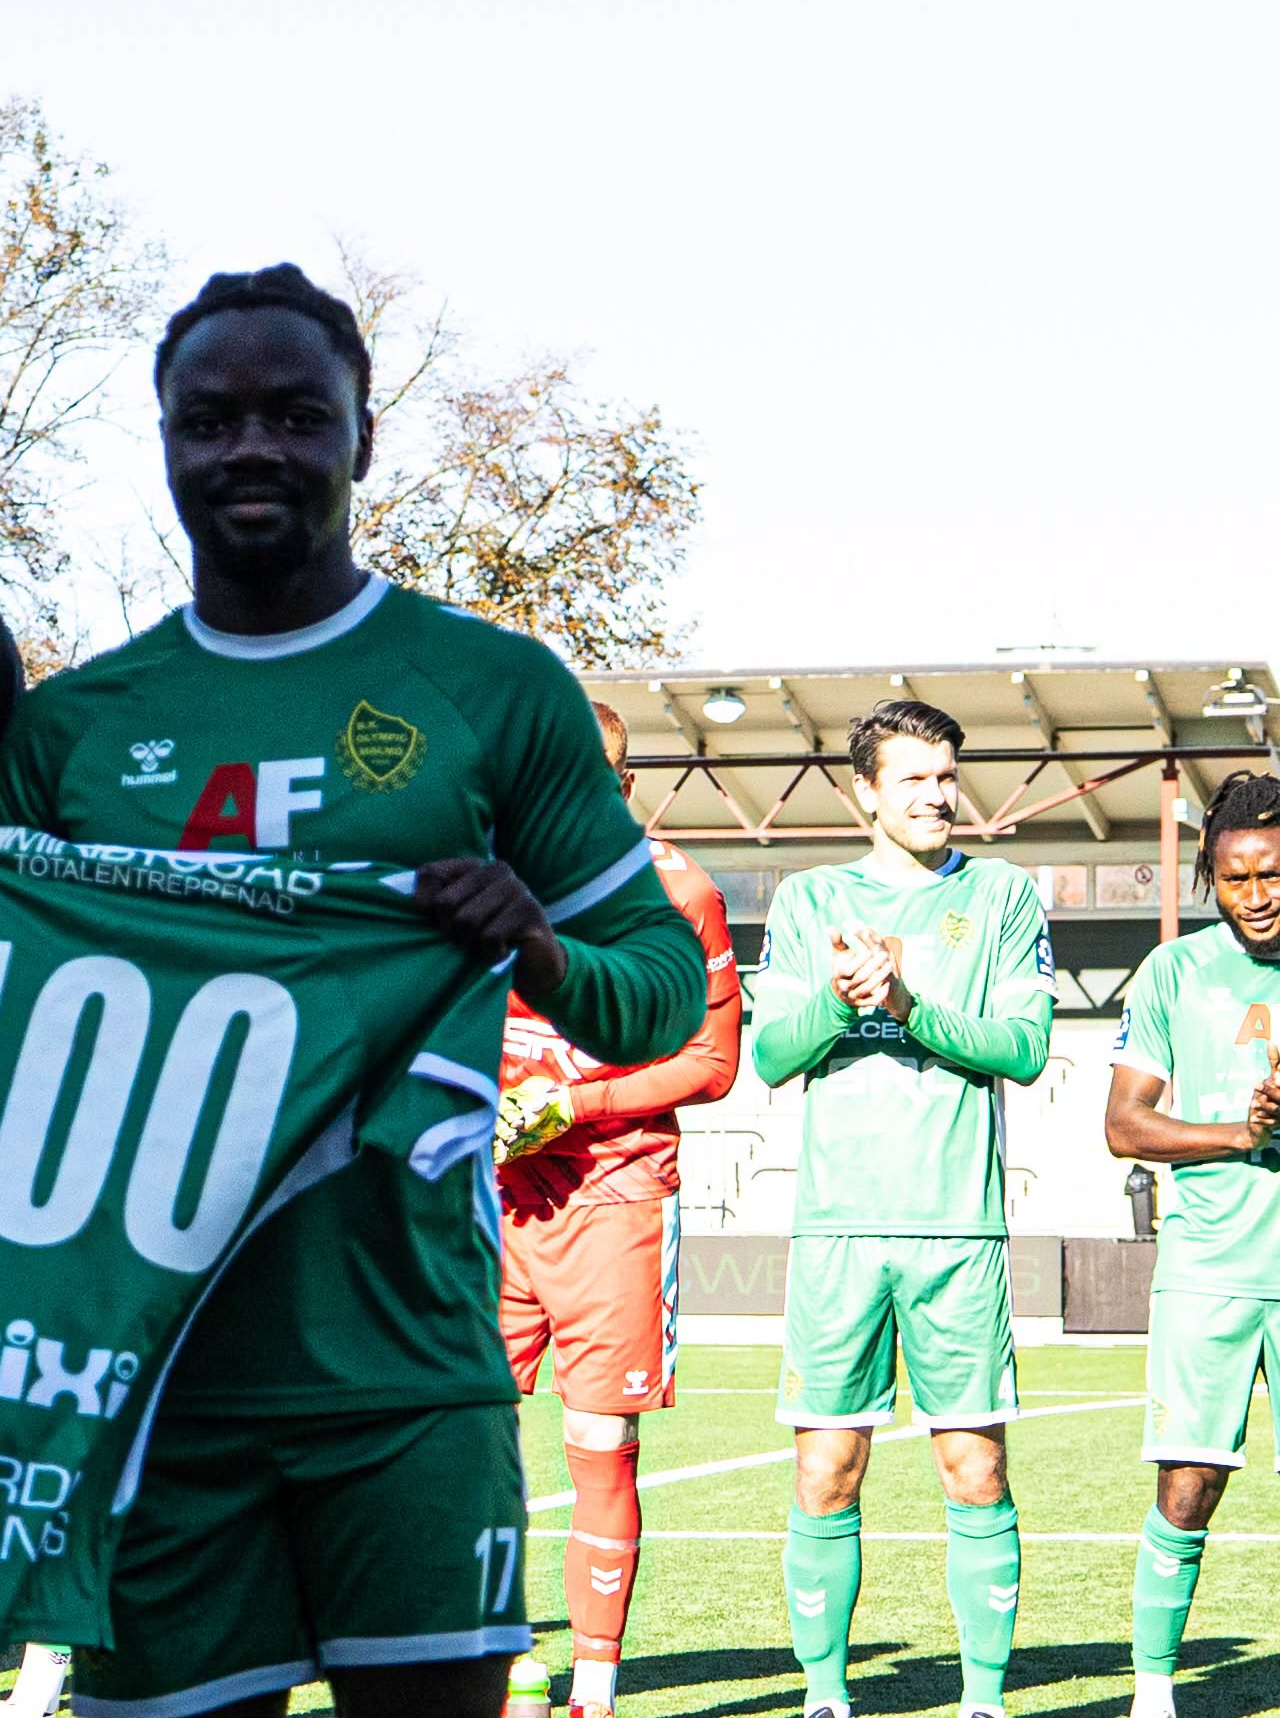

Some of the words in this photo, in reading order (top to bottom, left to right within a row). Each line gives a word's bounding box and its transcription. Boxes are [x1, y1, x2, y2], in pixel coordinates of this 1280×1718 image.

[121, 769, 177, 787] hummel
[176, 756, 325, 852] AF
[15, 853, 295, 915] TOTALENTREPRENAD
[840, 1020, 904, 1040] LCE
[474, 1526, 517, 1613] 17
